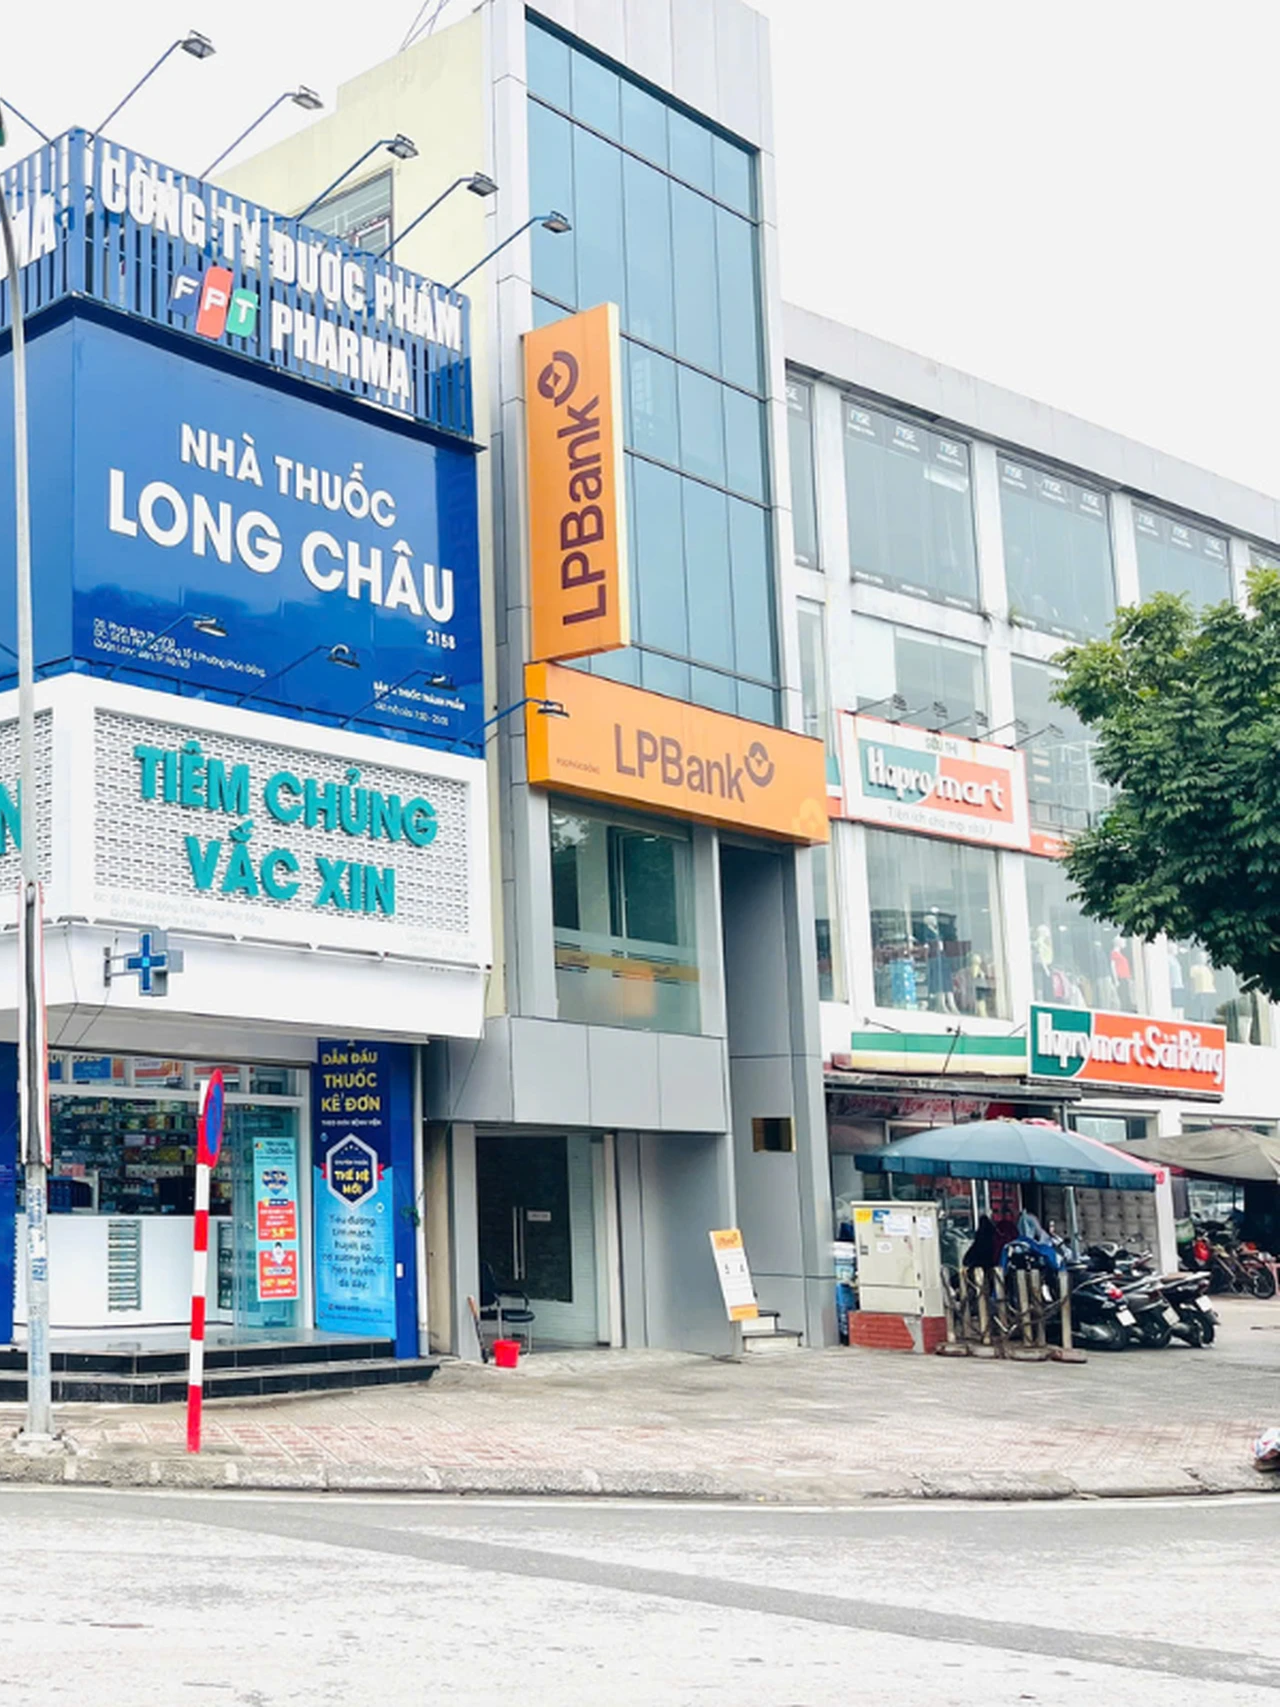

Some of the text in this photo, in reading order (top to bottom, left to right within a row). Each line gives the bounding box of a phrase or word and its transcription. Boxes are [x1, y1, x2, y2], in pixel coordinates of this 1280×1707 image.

[100, 149, 206, 249] CÔNG
[272, 230, 365, 312] DƯỢC
[375, 274, 462, 351] PHẨM
[172, 271, 410, 398] FPT PHARMA
[181, 423, 396, 528] NHÀ THUỐC
[558, 395, 607, 625] LPBank
[108, 468, 455, 623] LONG CHÂU
[426, 629, 456, 650] 2158
[134, 740, 439, 848] TIÊM CHỦNG
[614, 723, 745, 803] LPBank
[185, 820, 302, 902] VẮC
[313, 857, 396, 916] XIN
[323, 1068, 377, 1088] THUỐC
[345, 1094, 380, 1112] ĐƠN
